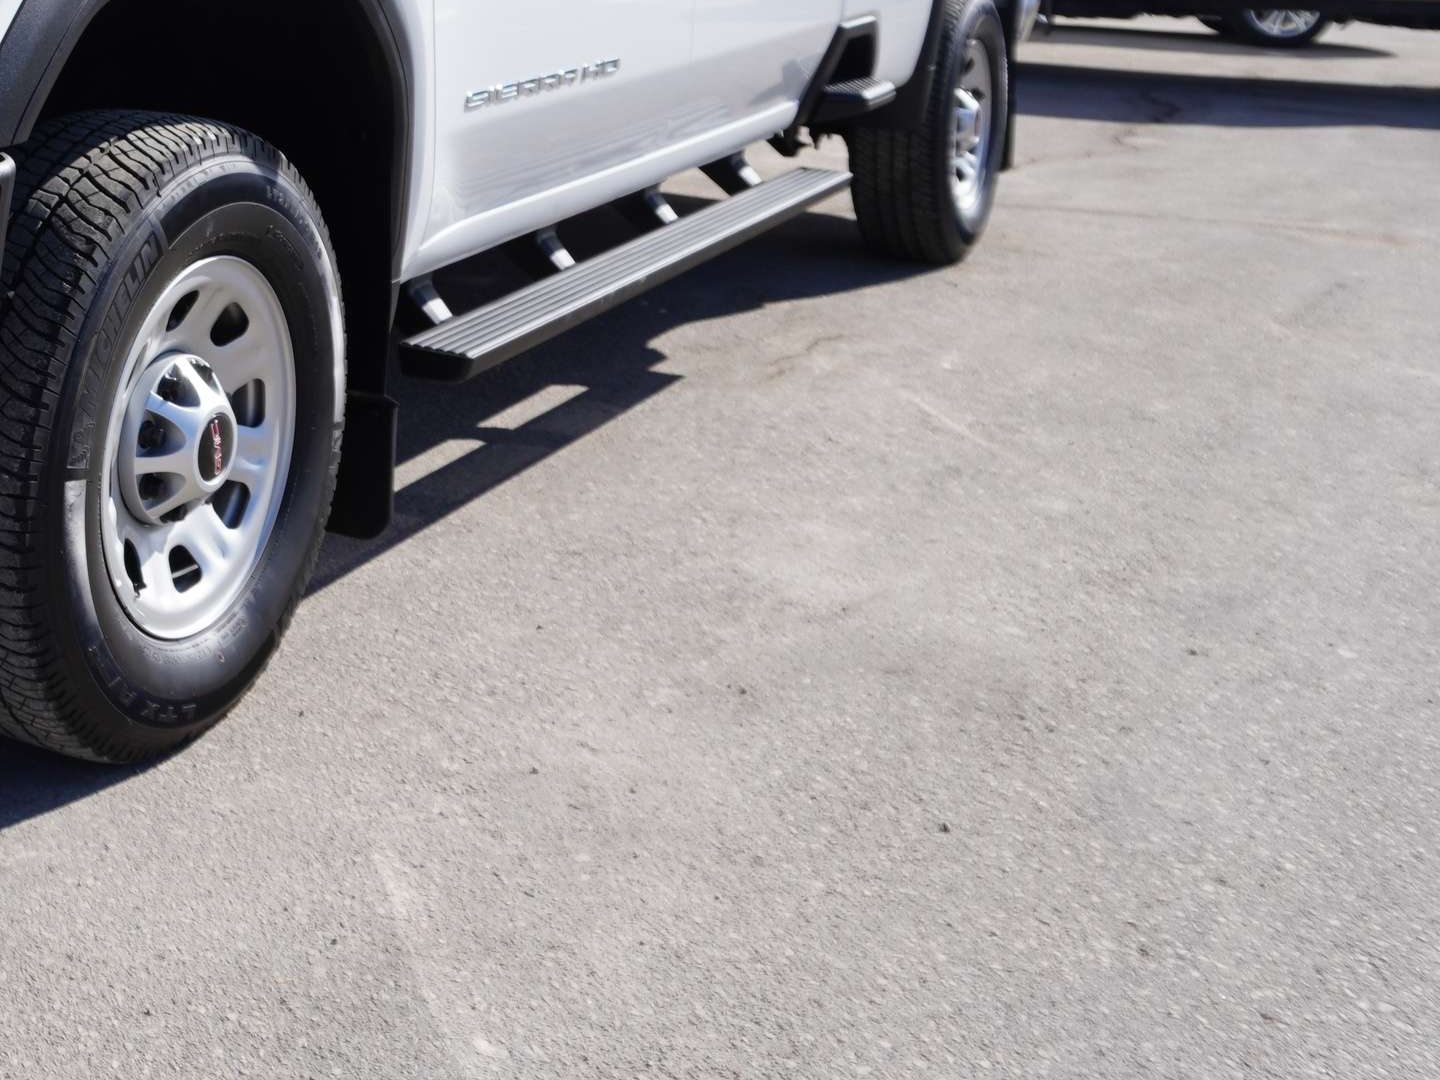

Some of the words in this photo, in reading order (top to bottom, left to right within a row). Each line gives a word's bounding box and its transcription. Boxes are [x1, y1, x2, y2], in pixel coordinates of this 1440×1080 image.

[463, 69, 579, 114] SIERRA
[580, 57, 621, 84] HD
[76, 229, 164, 420] MICHELIN
